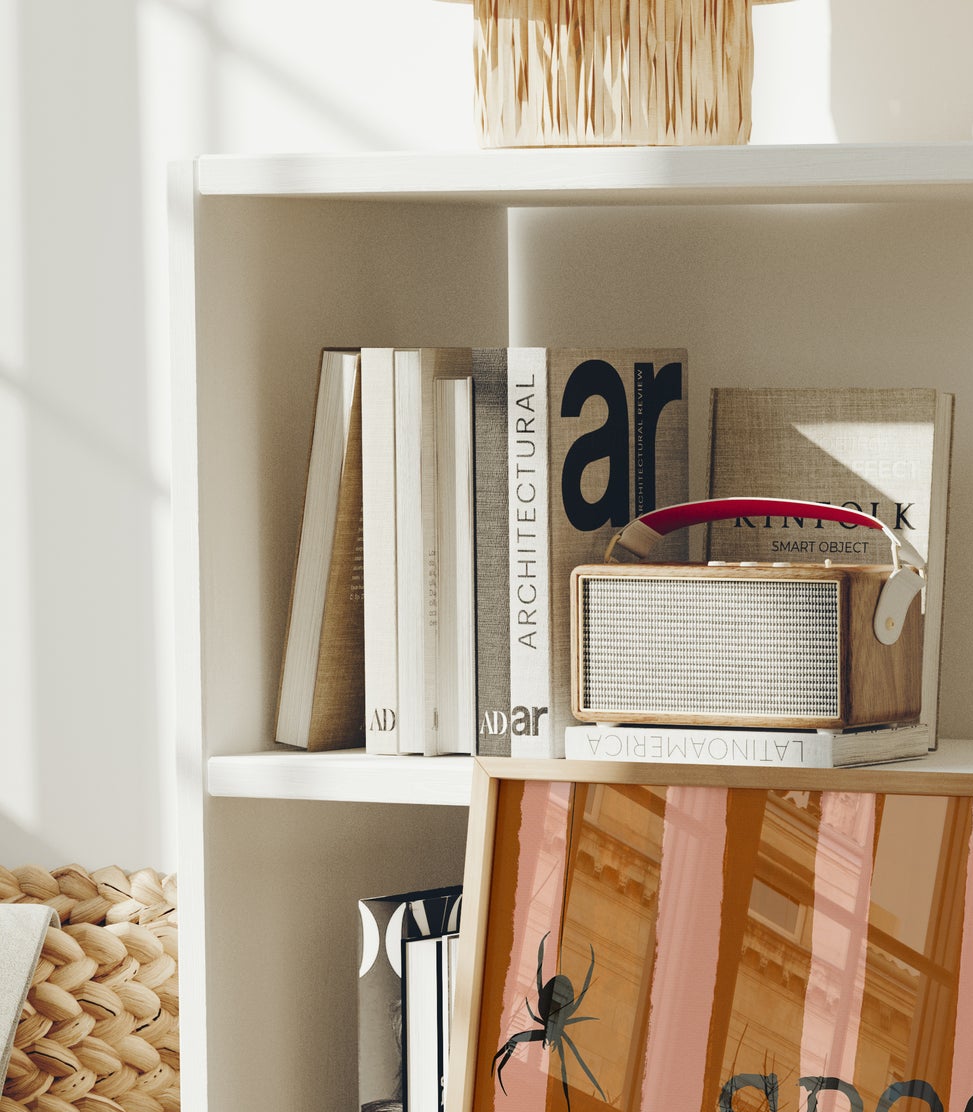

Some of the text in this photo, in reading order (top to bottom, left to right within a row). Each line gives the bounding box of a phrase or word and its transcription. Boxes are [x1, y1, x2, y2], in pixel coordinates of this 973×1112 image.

[560, 359, 682, 531] ar
[516, 373, 538, 650] ARCHITECTURAL
[771, 541, 869, 554] SMART OBJECT
[369, 708, 396, 732] AD
[479, 710, 508, 736] AD
[511, 705, 548, 737] ar
[586, 734, 804, 763] LATINOAMERICA
